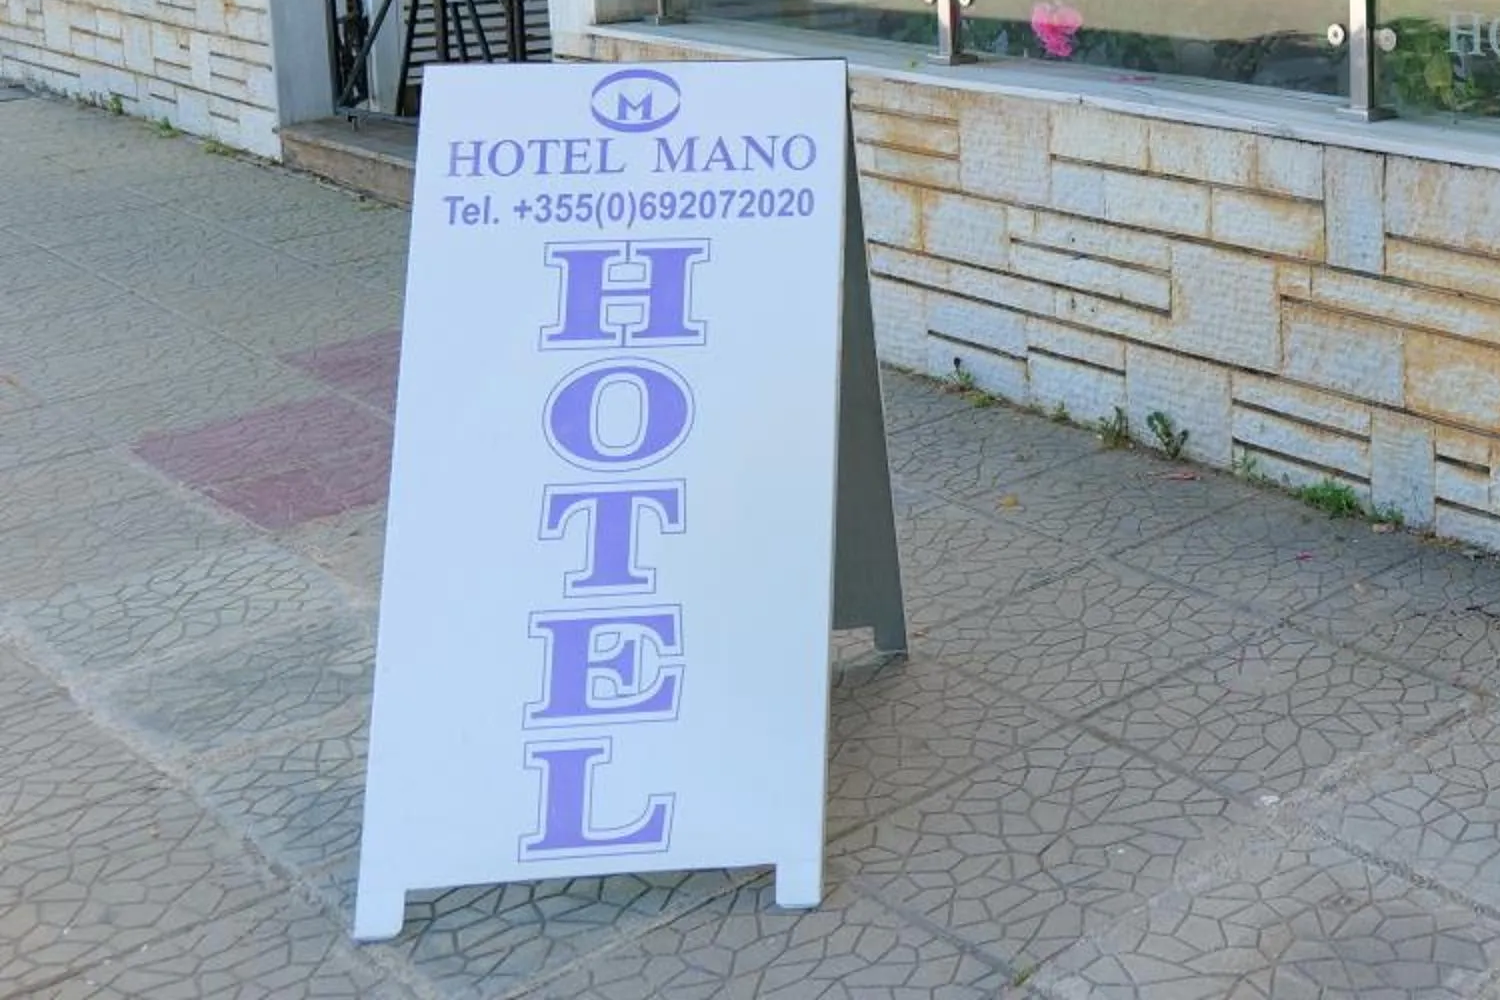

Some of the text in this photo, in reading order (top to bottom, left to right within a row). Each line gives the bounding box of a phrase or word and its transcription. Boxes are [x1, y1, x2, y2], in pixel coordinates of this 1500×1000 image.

[447, 133, 818, 178] HOTEL MANO
[443, 187, 816, 230] Tel. +355(0)692072020
[517, 237, 712, 863] HOTEL
